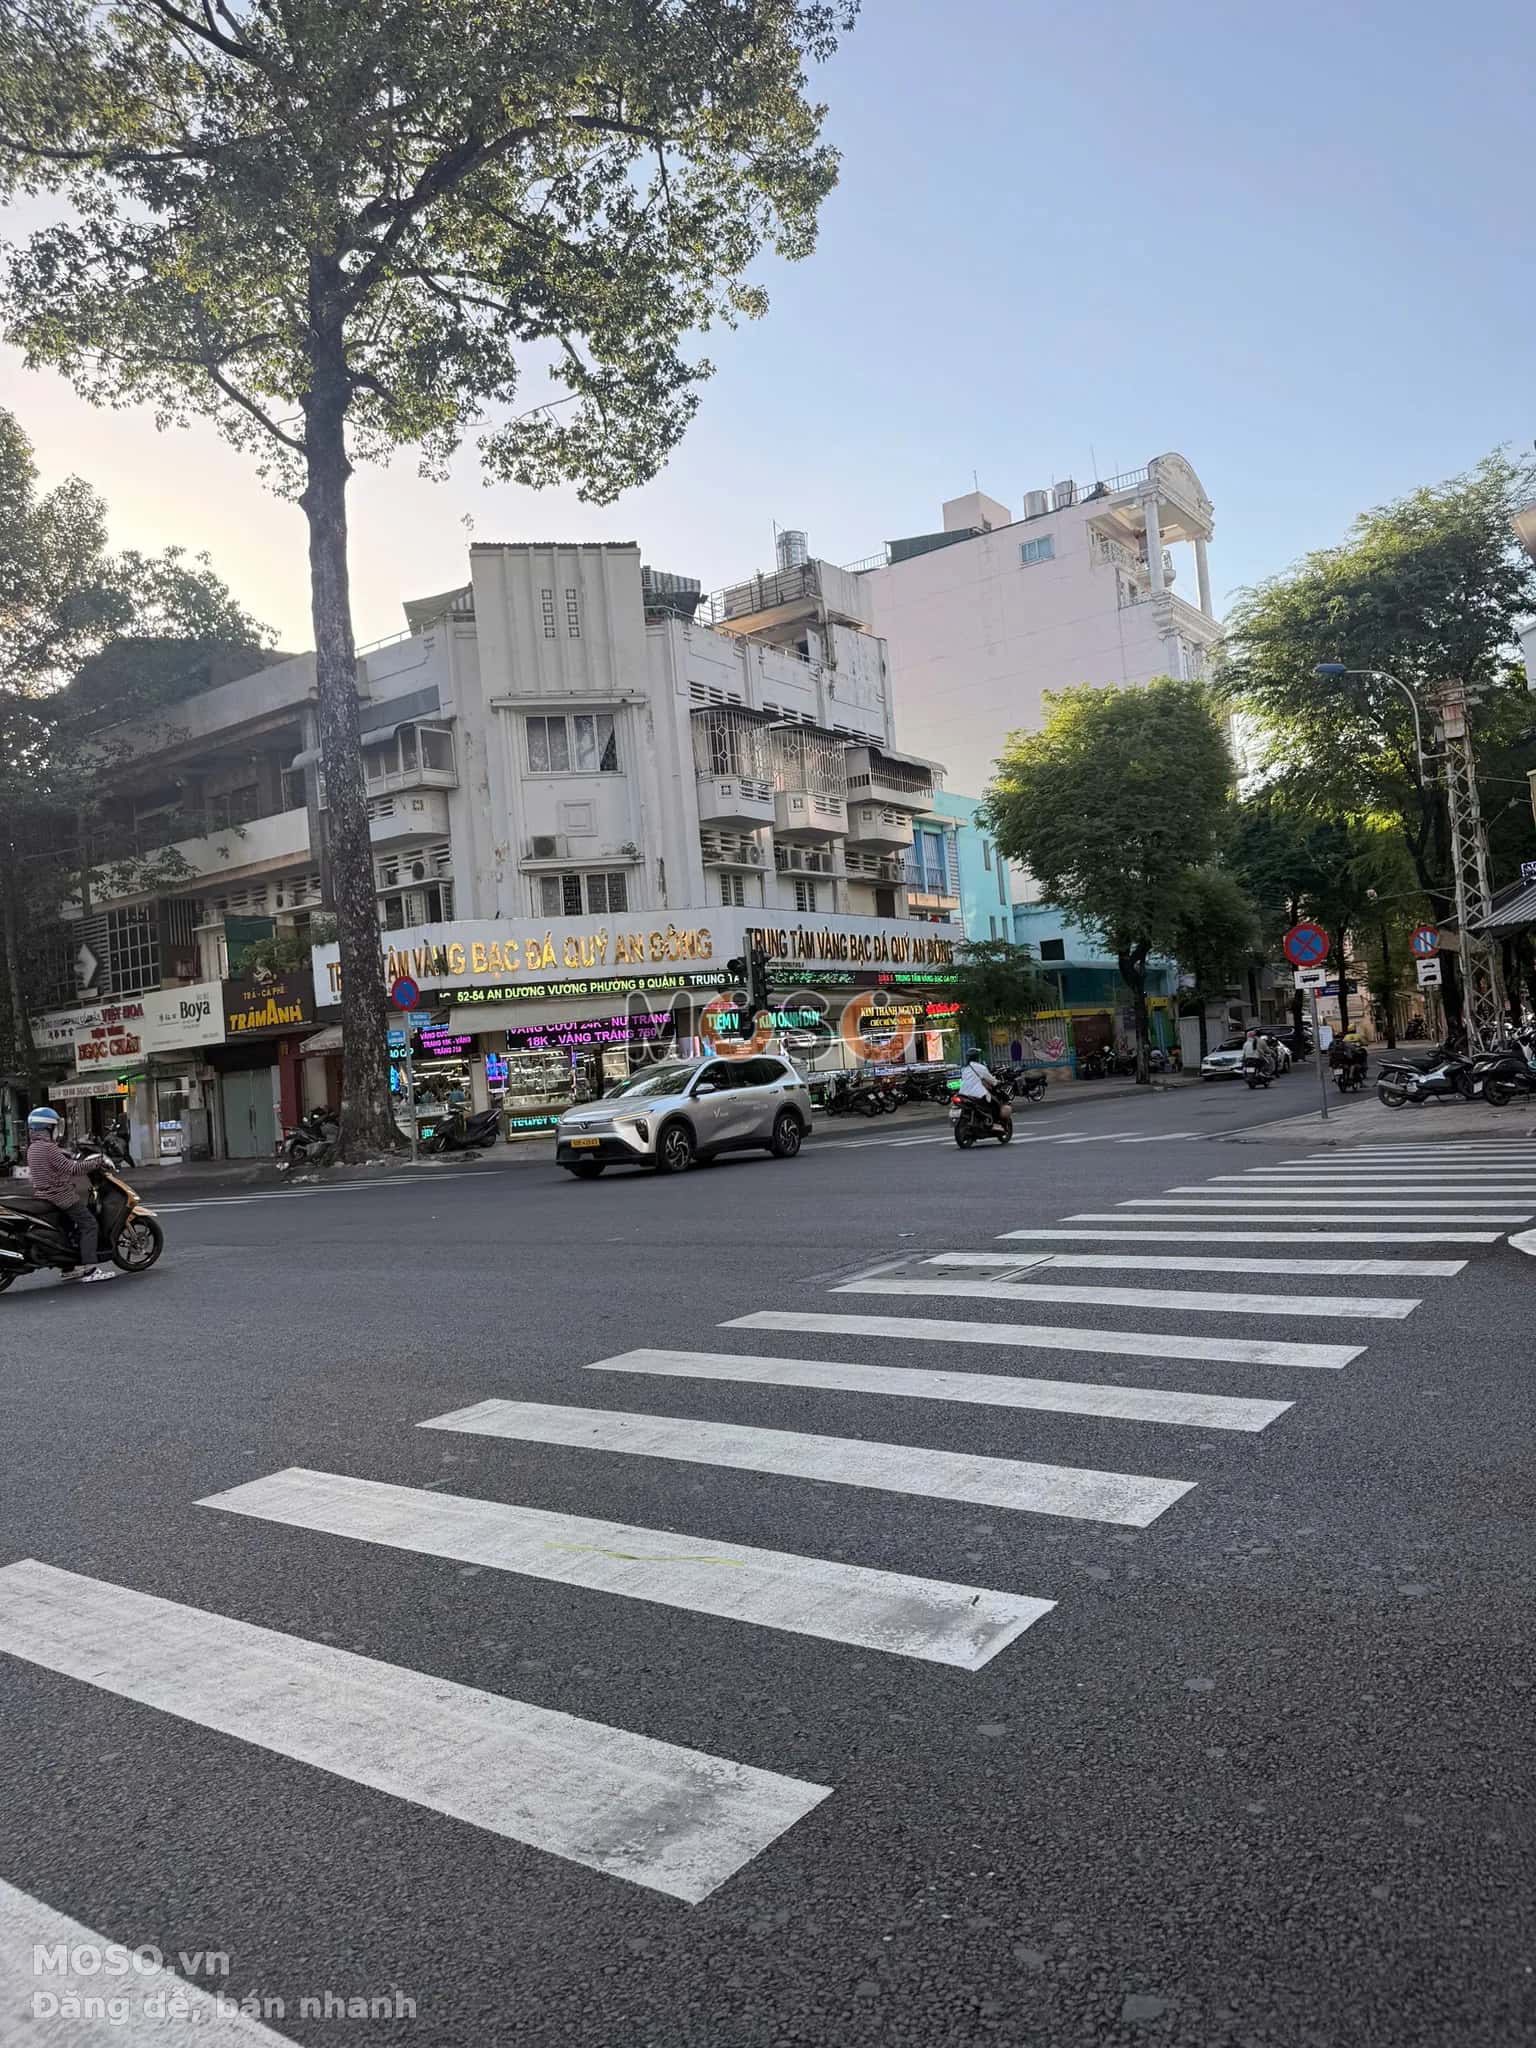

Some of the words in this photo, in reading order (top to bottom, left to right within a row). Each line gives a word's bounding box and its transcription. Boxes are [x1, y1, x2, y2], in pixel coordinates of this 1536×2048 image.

[384, 944, 410, 983] ÂM
[413, 939, 465, 977] VÀNG
[471, 939, 520, 977] BẠC
[525, 930, 557, 970] ĐÁ
[564, 927, 609, 968] QUÝ
[615, 933, 644, 965] AN
[649, 923, 713, 961] ĐÔNG
[745, 927, 788, 958] TRUNG
[790, 923, 816, 960] TÂM
[817, 926, 848, 960] VÀNG
[849, 934, 872, 966] BẠC
[874, 930, 888, 961] ĐÁ
[891, 932, 910, 963] QUÝ
[913, 938, 925, 964] AN
[487, 989, 502, 1000] AN
[505, 986, 545, 998] DƯƠNG
[548, 983, 587, 995] VƯƠNG
[690, 974, 725, 985] TRUNG
[179, 1000, 211, 1022] Boya
[526, 1036, 549, 1047] 18K
[558, 1031, 591, 1044] VÀNG
